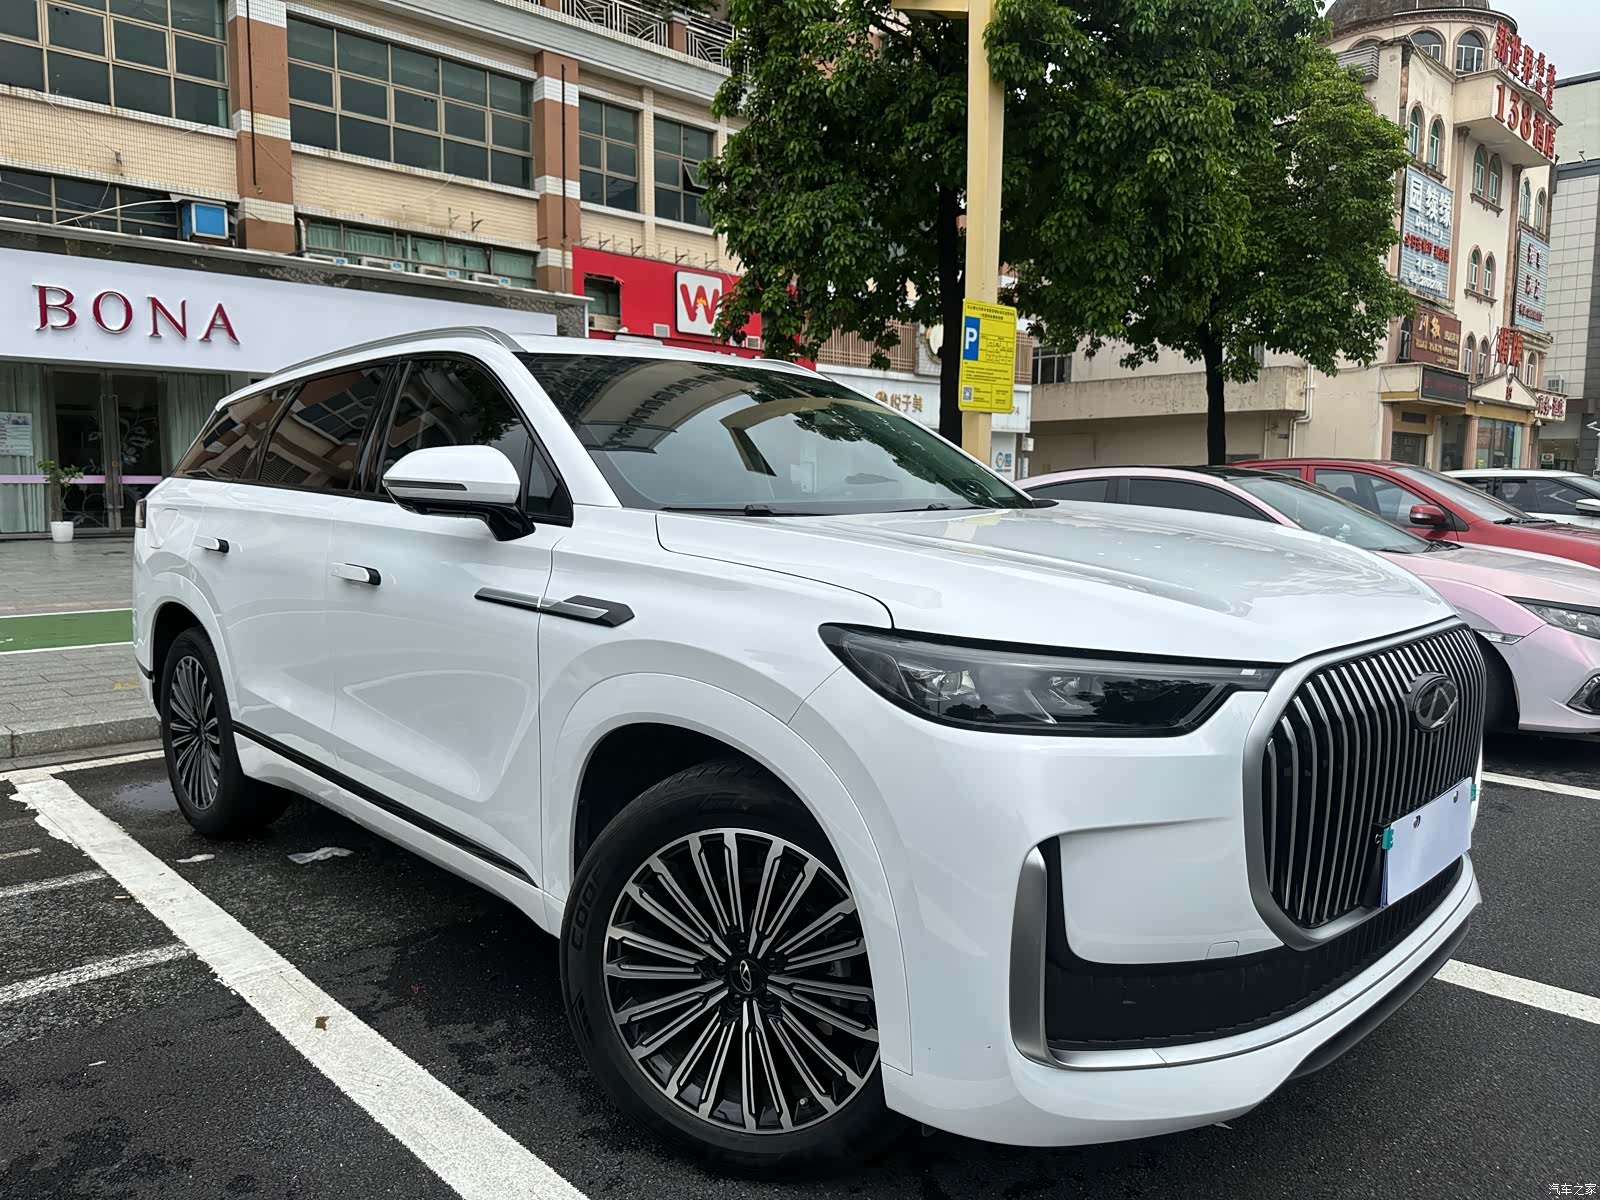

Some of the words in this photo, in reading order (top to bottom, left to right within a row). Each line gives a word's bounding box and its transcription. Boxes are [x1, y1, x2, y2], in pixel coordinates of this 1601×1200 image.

[1495, 84, 1555, 159] 138酒店
[32, 284, 240, 345] BONA
[965, 327, 978, 350] P
